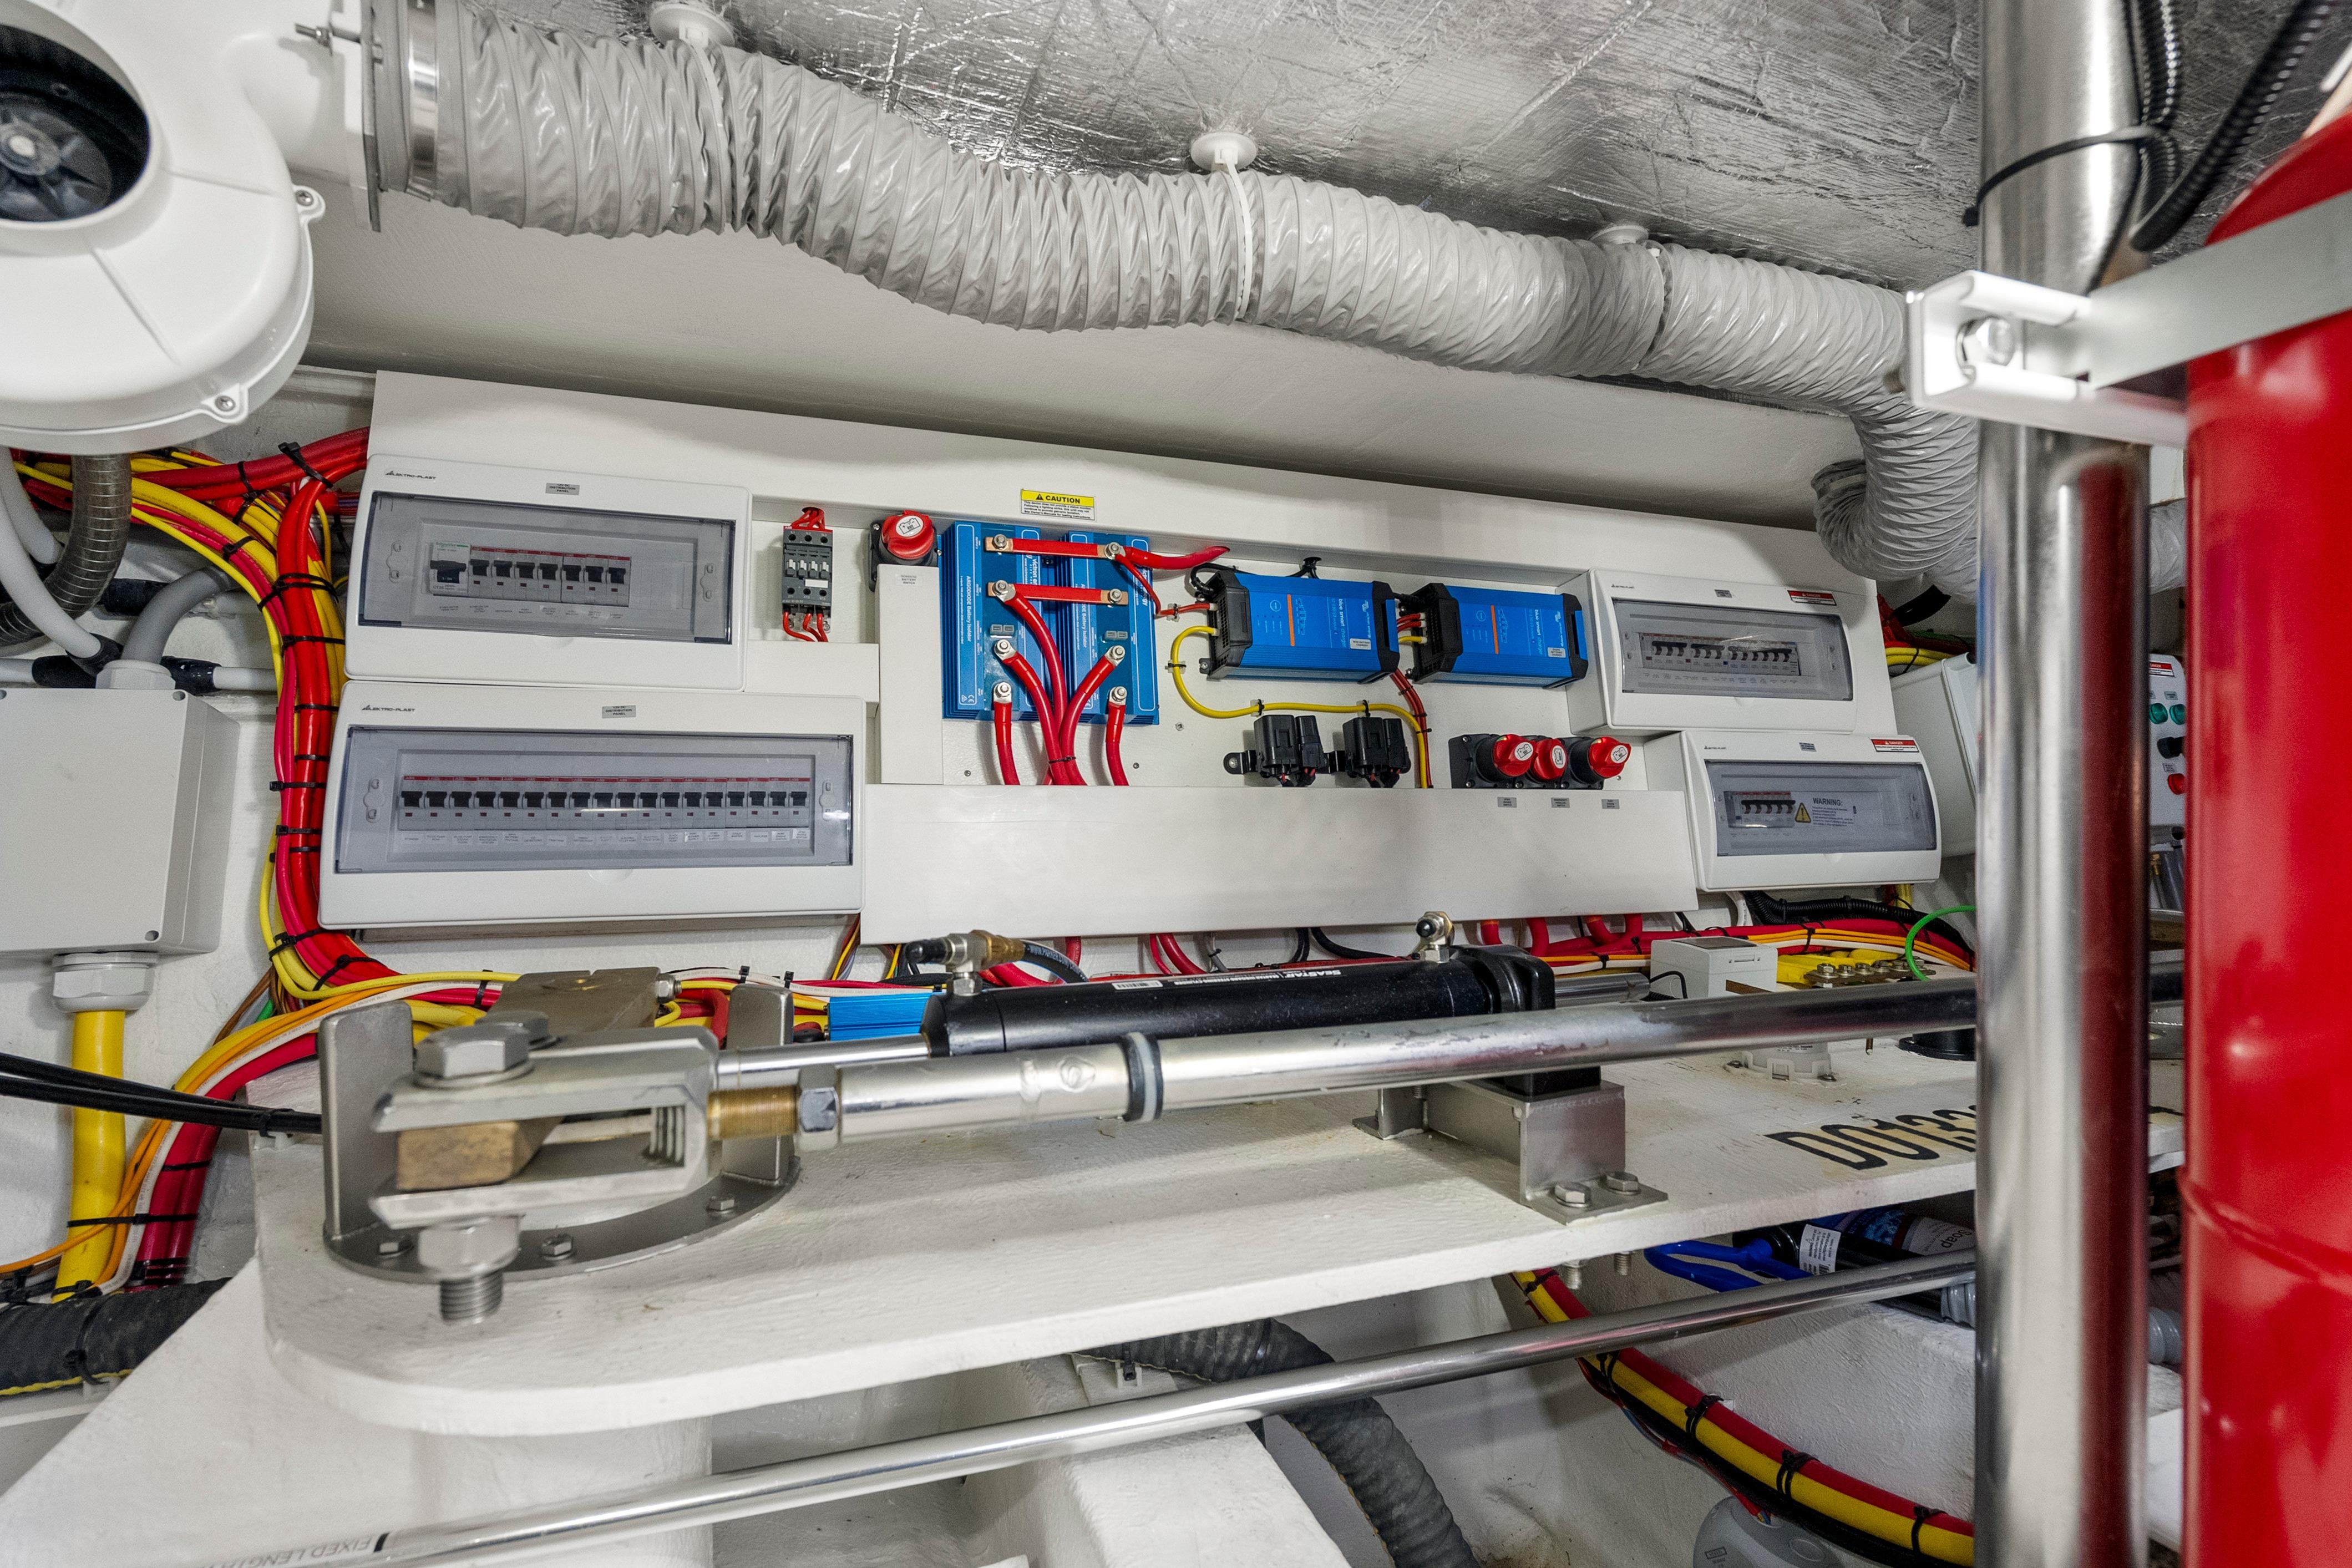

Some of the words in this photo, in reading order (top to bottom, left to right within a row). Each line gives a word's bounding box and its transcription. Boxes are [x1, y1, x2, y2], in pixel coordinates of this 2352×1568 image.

[1046, 495, 1081, 504] CAUTION
[1812, 798, 1843, 806] WARNING:
[1285, 970, 1341, 978] SEASTAR
[1941, 1229, 1972, 1249] Soap
[311, 1537, 372, 1559] FIXED
